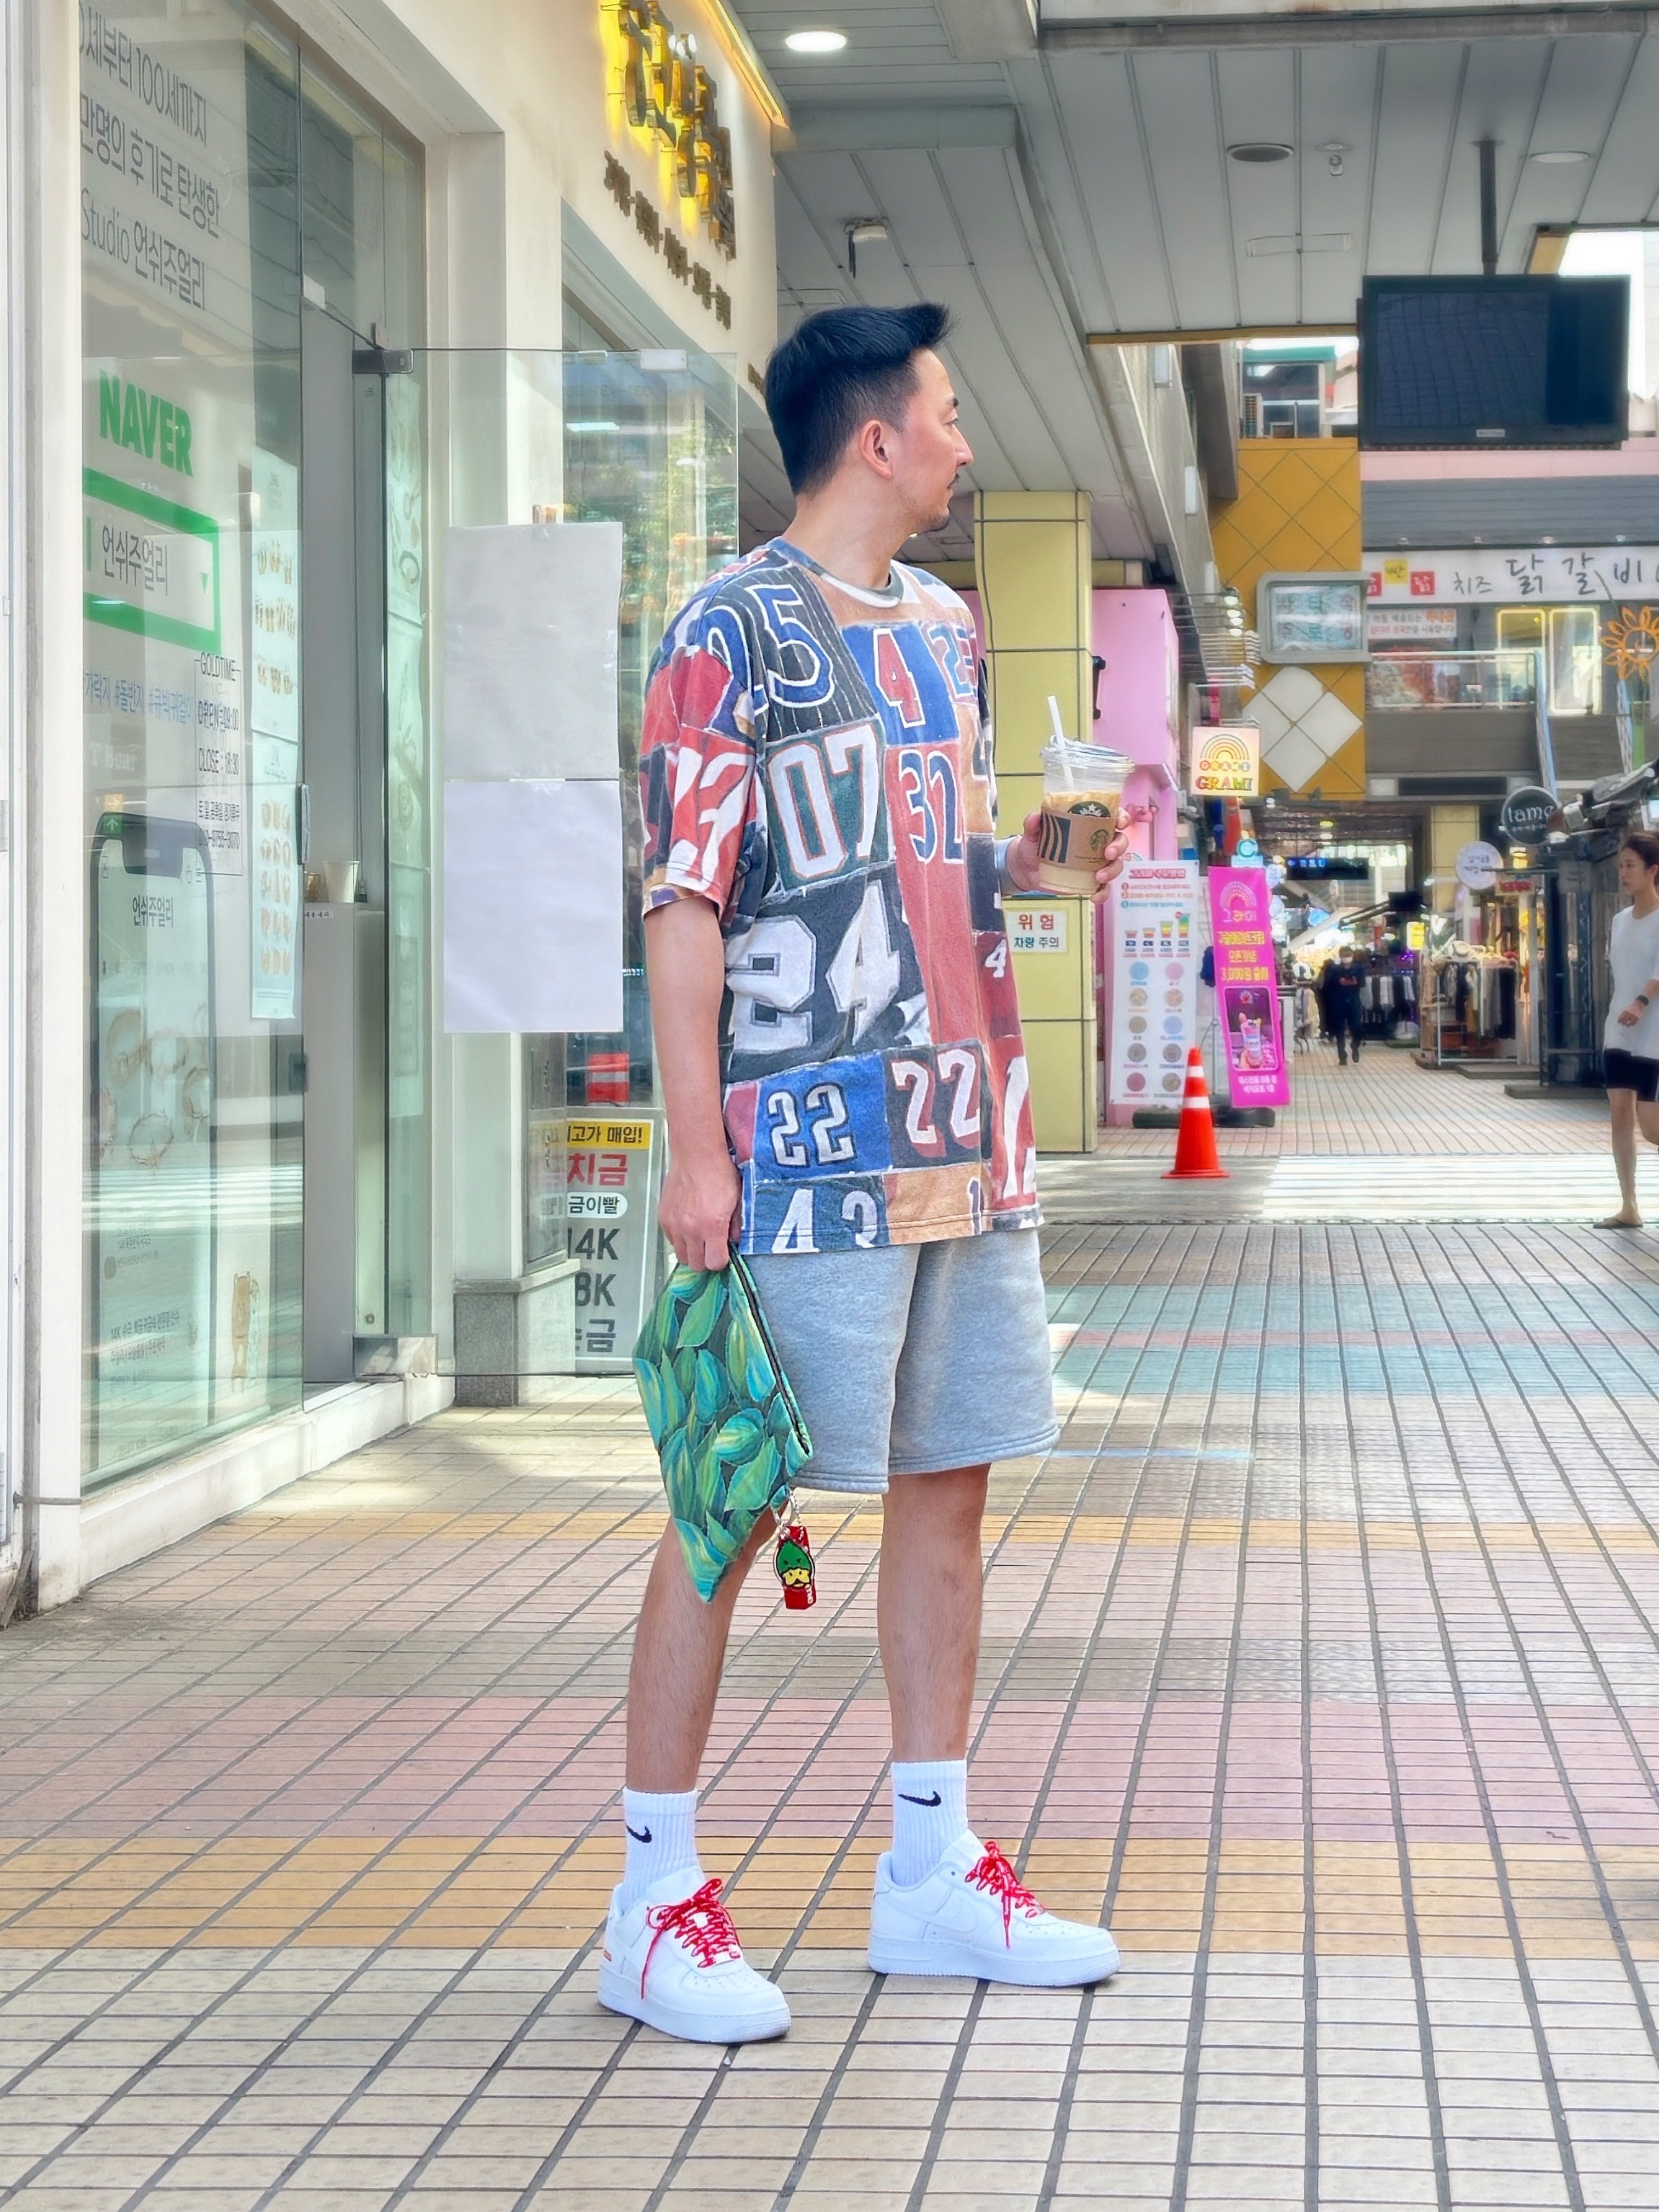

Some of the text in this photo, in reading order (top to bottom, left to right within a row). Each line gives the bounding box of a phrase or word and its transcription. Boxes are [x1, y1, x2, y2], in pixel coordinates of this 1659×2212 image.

[137, 47, 206, 147] 100세까지
[131, 129, 173, 207] 후기로
[178, 163, 219, 239] 탄생한
[81, 187, 205, 310] Studio 언쉬주얼리
[100, 369, 193, 477] NAVER
[103, 525, 168, 597] 언쉬주얼리
[1454, 572, 1492, 595] 치즈
[878, 629, 926, 727] 4
[199, 748, 219, 774] CLOSE
[766, 724, 879, 879] 07
[132, 895, 173, 928] 언쉬주얼리
[1018, 914, 1053, 930] 위험
[985, 939, 1007, 978] 4
[1014, 936, 1059, 948] 차량 주의
[891, 1047, 983, 1147] 22
[567, 1126, 642, 1143] 고가 매입!
[766, 1080, 858, 1170] 22
[567, 1153, 628, 1186] 치금
[568, 1196, 620, 1214] 금이빨
[575, 1272, 617, 1306] 8K
[575, 1318, 616, 1353] 금
